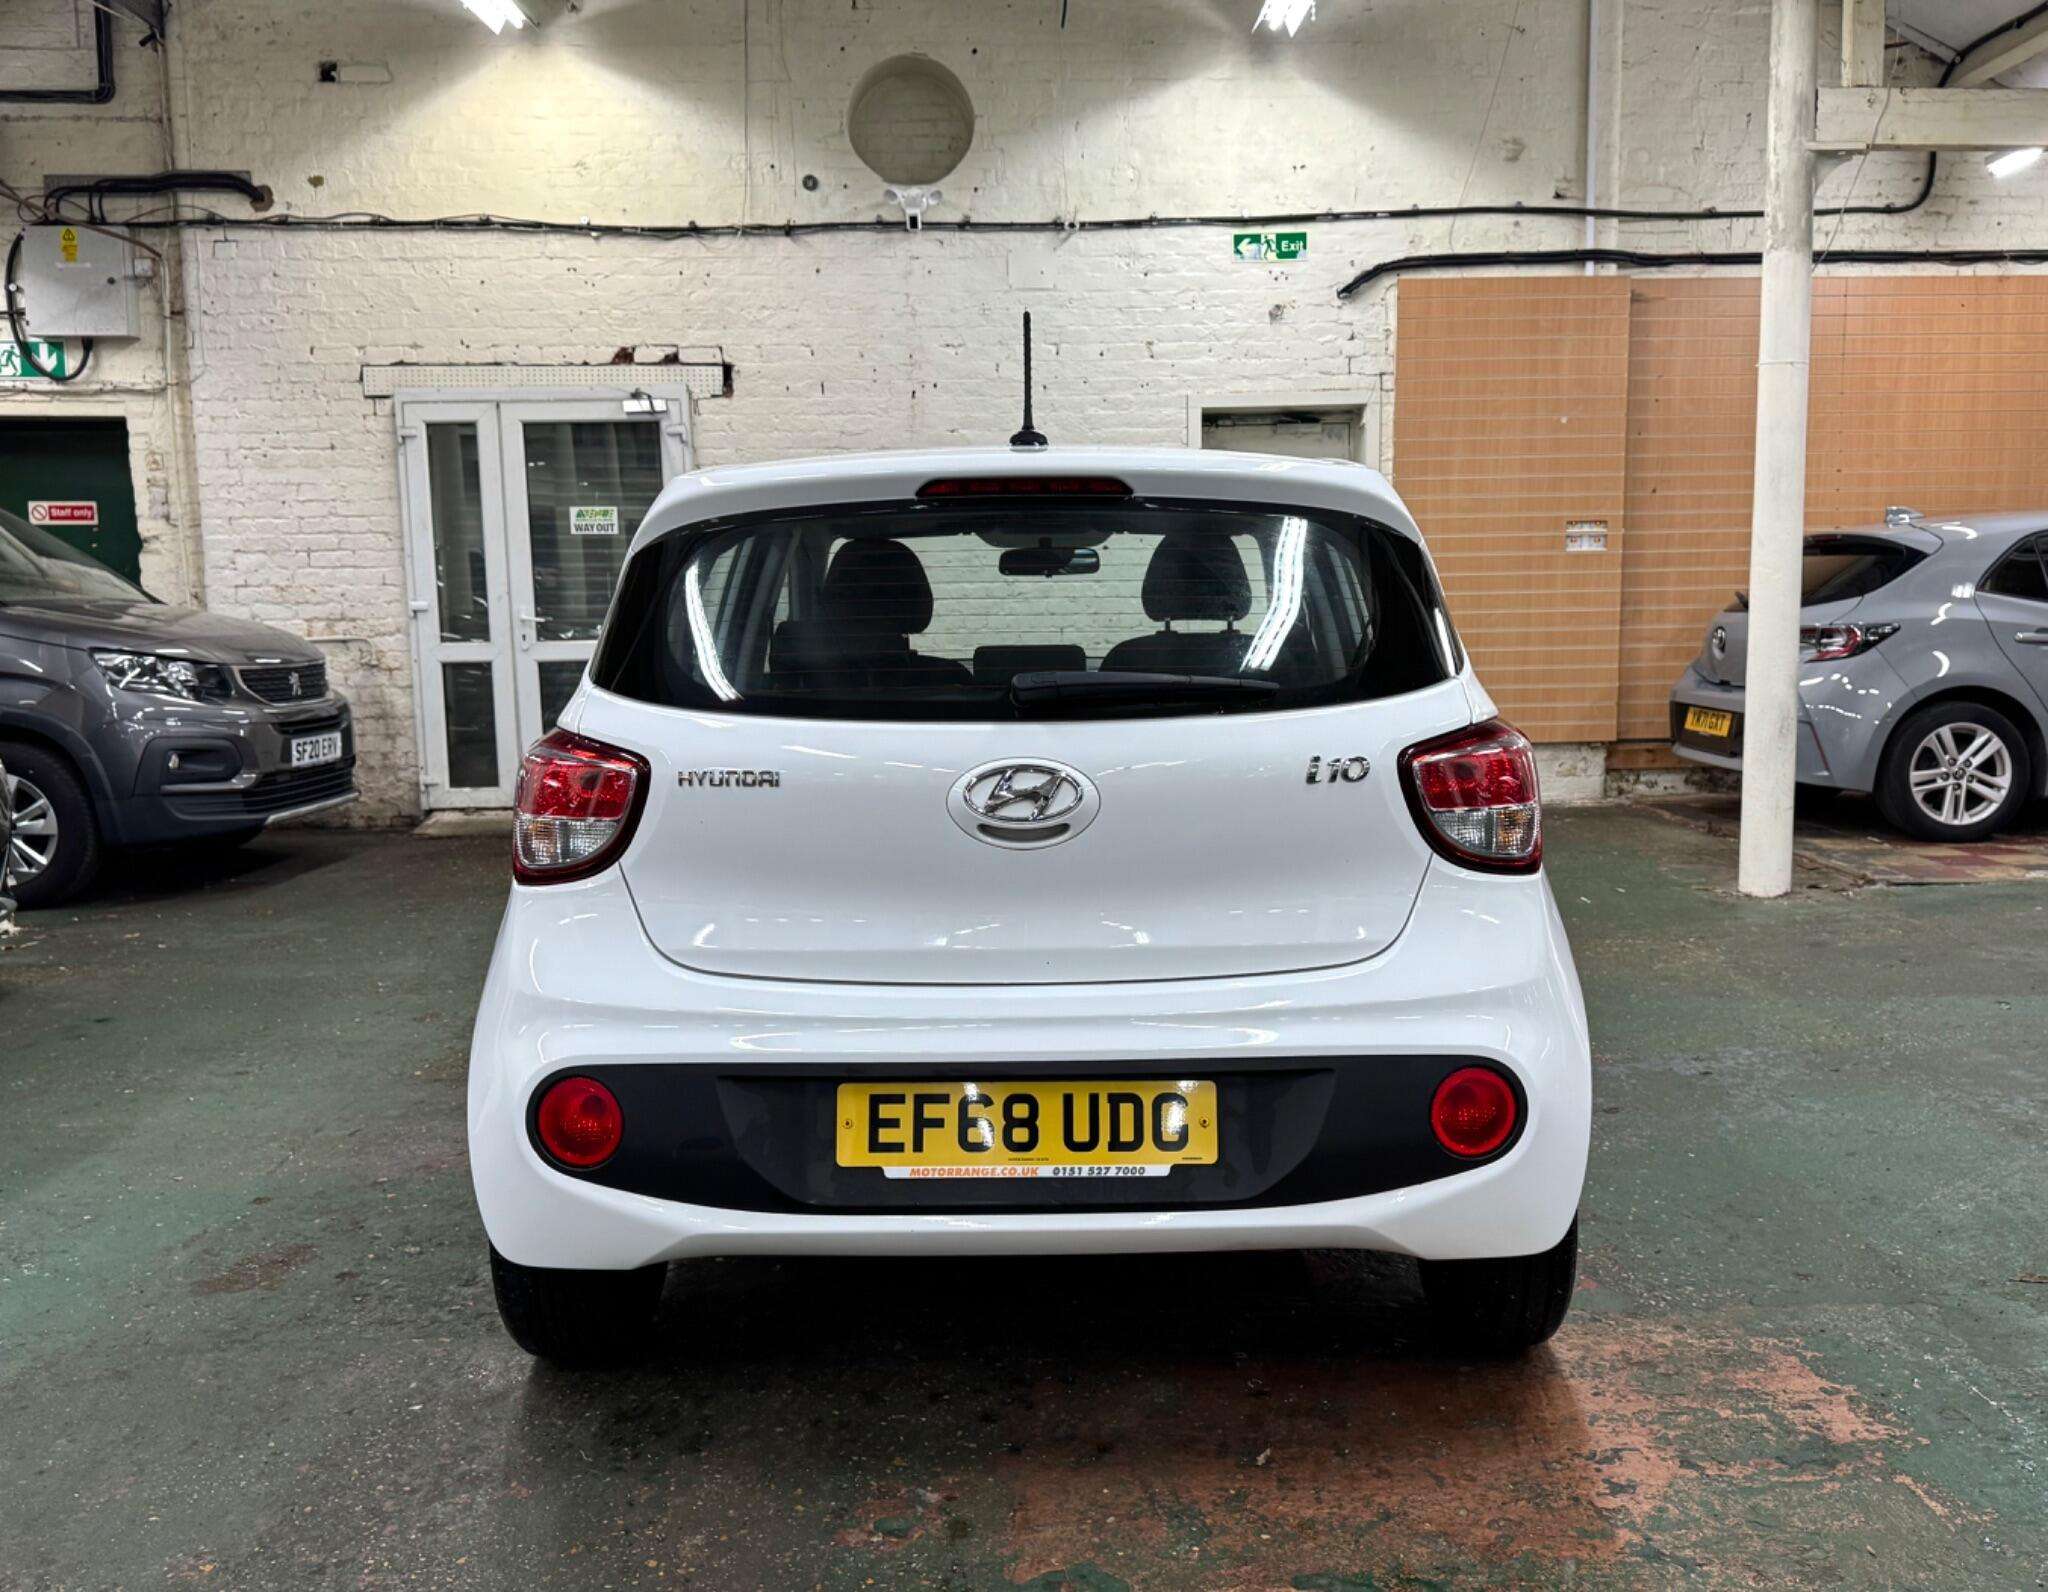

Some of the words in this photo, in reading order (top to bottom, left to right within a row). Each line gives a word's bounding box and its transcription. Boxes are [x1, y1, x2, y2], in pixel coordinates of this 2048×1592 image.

[1281, 240, 1304, 252] Exit
[50, 507, 72, 518] Staff
[73, 508, 92, 519] only
[573, 523, 595, 532] WAY
[596, 522, 616, 532] OUT
[296, 740, 320, 762] SF20
[1306, 755, 1370, 784] i10
[678, 770, 780, 787] HYUNDAI
[868, 1093, 1039, 1153] EF68
[1062, 1092, 1189, 1152] UDG
[909, 1167, 1040, 1177] MOTORRANGE.CO.UK
[1053, 1166, 1083, 1176] 0151
[1088, 1166, 1111, 1175] 527
[1115, 1166, 1146, 1175] 7000
